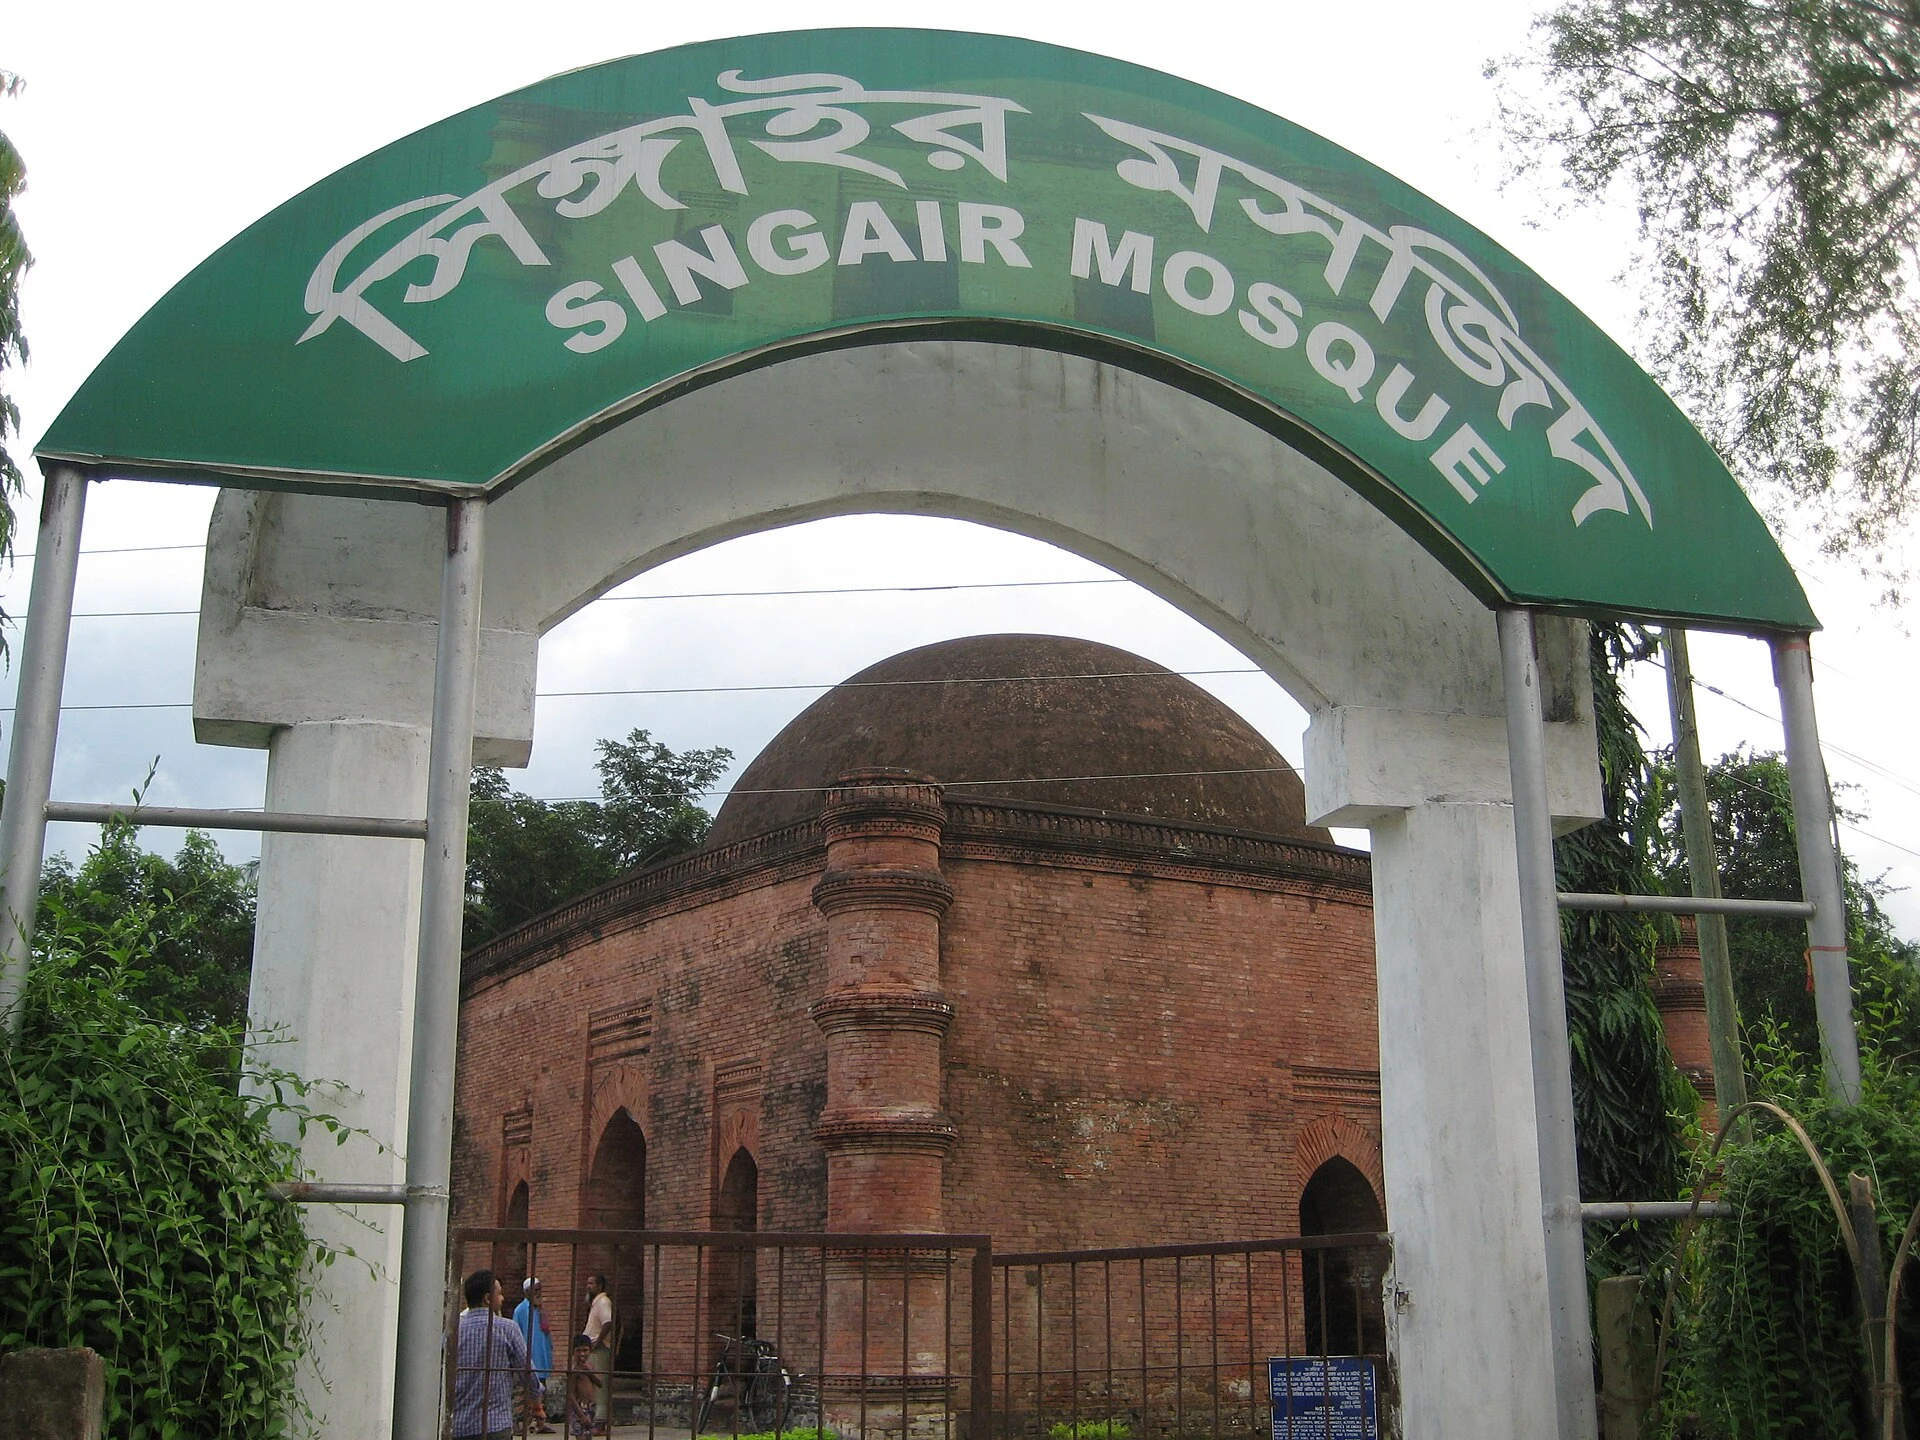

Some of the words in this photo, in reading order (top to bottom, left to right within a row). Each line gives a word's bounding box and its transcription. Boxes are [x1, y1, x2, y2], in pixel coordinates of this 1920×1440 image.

[295, 69, 1032, 362] সিঙ্গাইর
[1081, 112, 1652, 529] মসজিদ
[545, 200, 1032, 354] SINGAIR
[1071, 217, 1505, 503] MOSQUE
